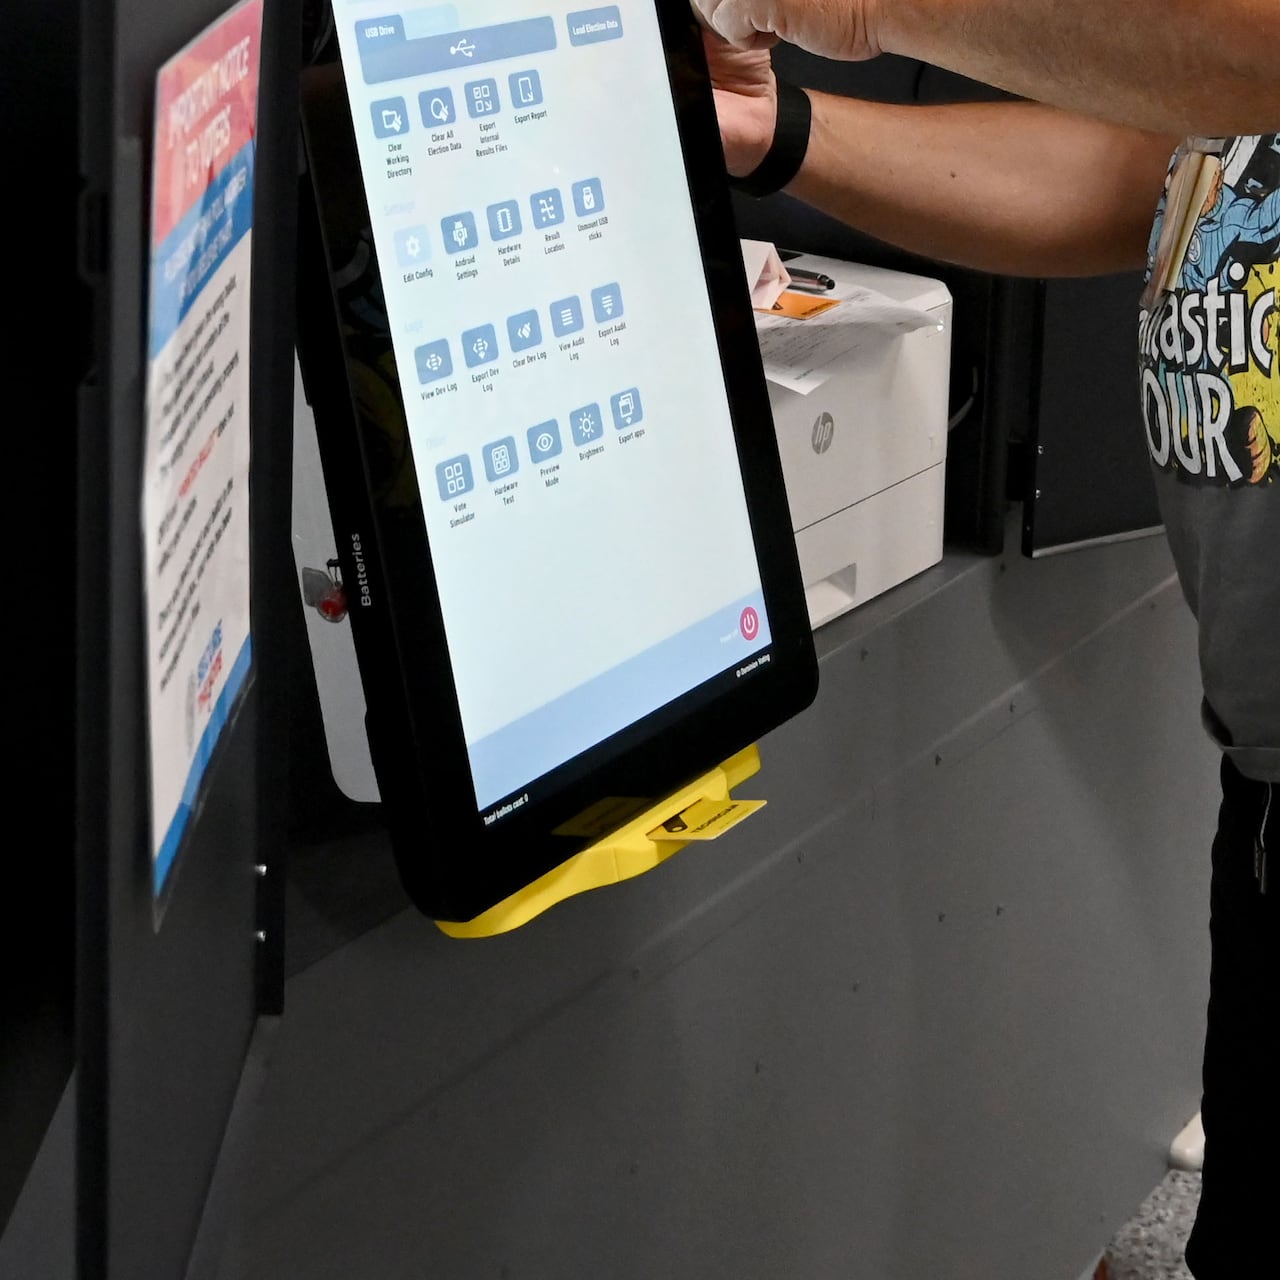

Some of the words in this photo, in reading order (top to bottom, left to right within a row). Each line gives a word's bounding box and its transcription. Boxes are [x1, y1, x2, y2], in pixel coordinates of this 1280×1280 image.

[364, 26, 378, 38] USB
[378, 24, 395, 36] Drive
[586, 22, 606, 34] Election
[606, 19, 618, 30] Data
[514, 112, 530, 125] Export
[530, 110, 548, 122] Report
[479, 121, 496, 134] Export
[432, 132, 446, 143] Clear
[480, 132, 500, 145] Internal
[388, 142, 402, 154] Clear
[428, 144, 448, 157] Election
[448, 142, 462, 154] Data
[476, 146, 495, 158] Results
[496, 143, 508, 154] Files
[386, 153, 410, 166] Working
[386, 166, 412, 179] Directory
[577, 219, 598, 233] Unmount
[598, 216, 609, 228] USB
[544, 231, 560, 243] Result
[588, 230, 602, 242] sticks
[498, 242, 522, 256] Hardware
[544, 243, 565, 256] Location
[454, 256, 476, 268] Android
[503, 256, 520, 267] Details
[403, 271, 415, 284] Edit
[415, 268, 434, 282] Config
[456, 268, 478, 282] Settings
[598, 327, 614, 338] Export
[614, 322, 626, 334] Audit
[558, 341, 572, 352] View
[572, 337, 586, 348] Audit
[610, 337, 620, 348] Log
[512, 357, 526, 369] Clear
[526, 354, 536, 365] Dev
[536, 350, 548, 362] Log
[570, 351, 580, 362] Log
[472, 372, 489, 384] Export
[489, 368, 500, 378] Dev
[421, 390, 436, 402] View
[436, 386, 446, 397] Dev
[446, 382, 458, 392] Log
[482, 384, 494, 393] Log
[618, 432, 632, 445] Export
[632, 428, 646, 441] apps
[813, 411, 833, 454] hp
[578, 444, 605, 461] Brightness
[540, 464, 560, 478] Preview
[494, 482, 518, 496] Hardware
[544, 476, 559, 488] Mode
[453, 502, 467, 513] Vote
[503, 495, 514, 506] Test
[450, 512, 476, 528] Simulator
[351, 533, 372, 606] Batteries
[484, 810, 496, 826] Total
[496, 804, 513, 819] ballots
